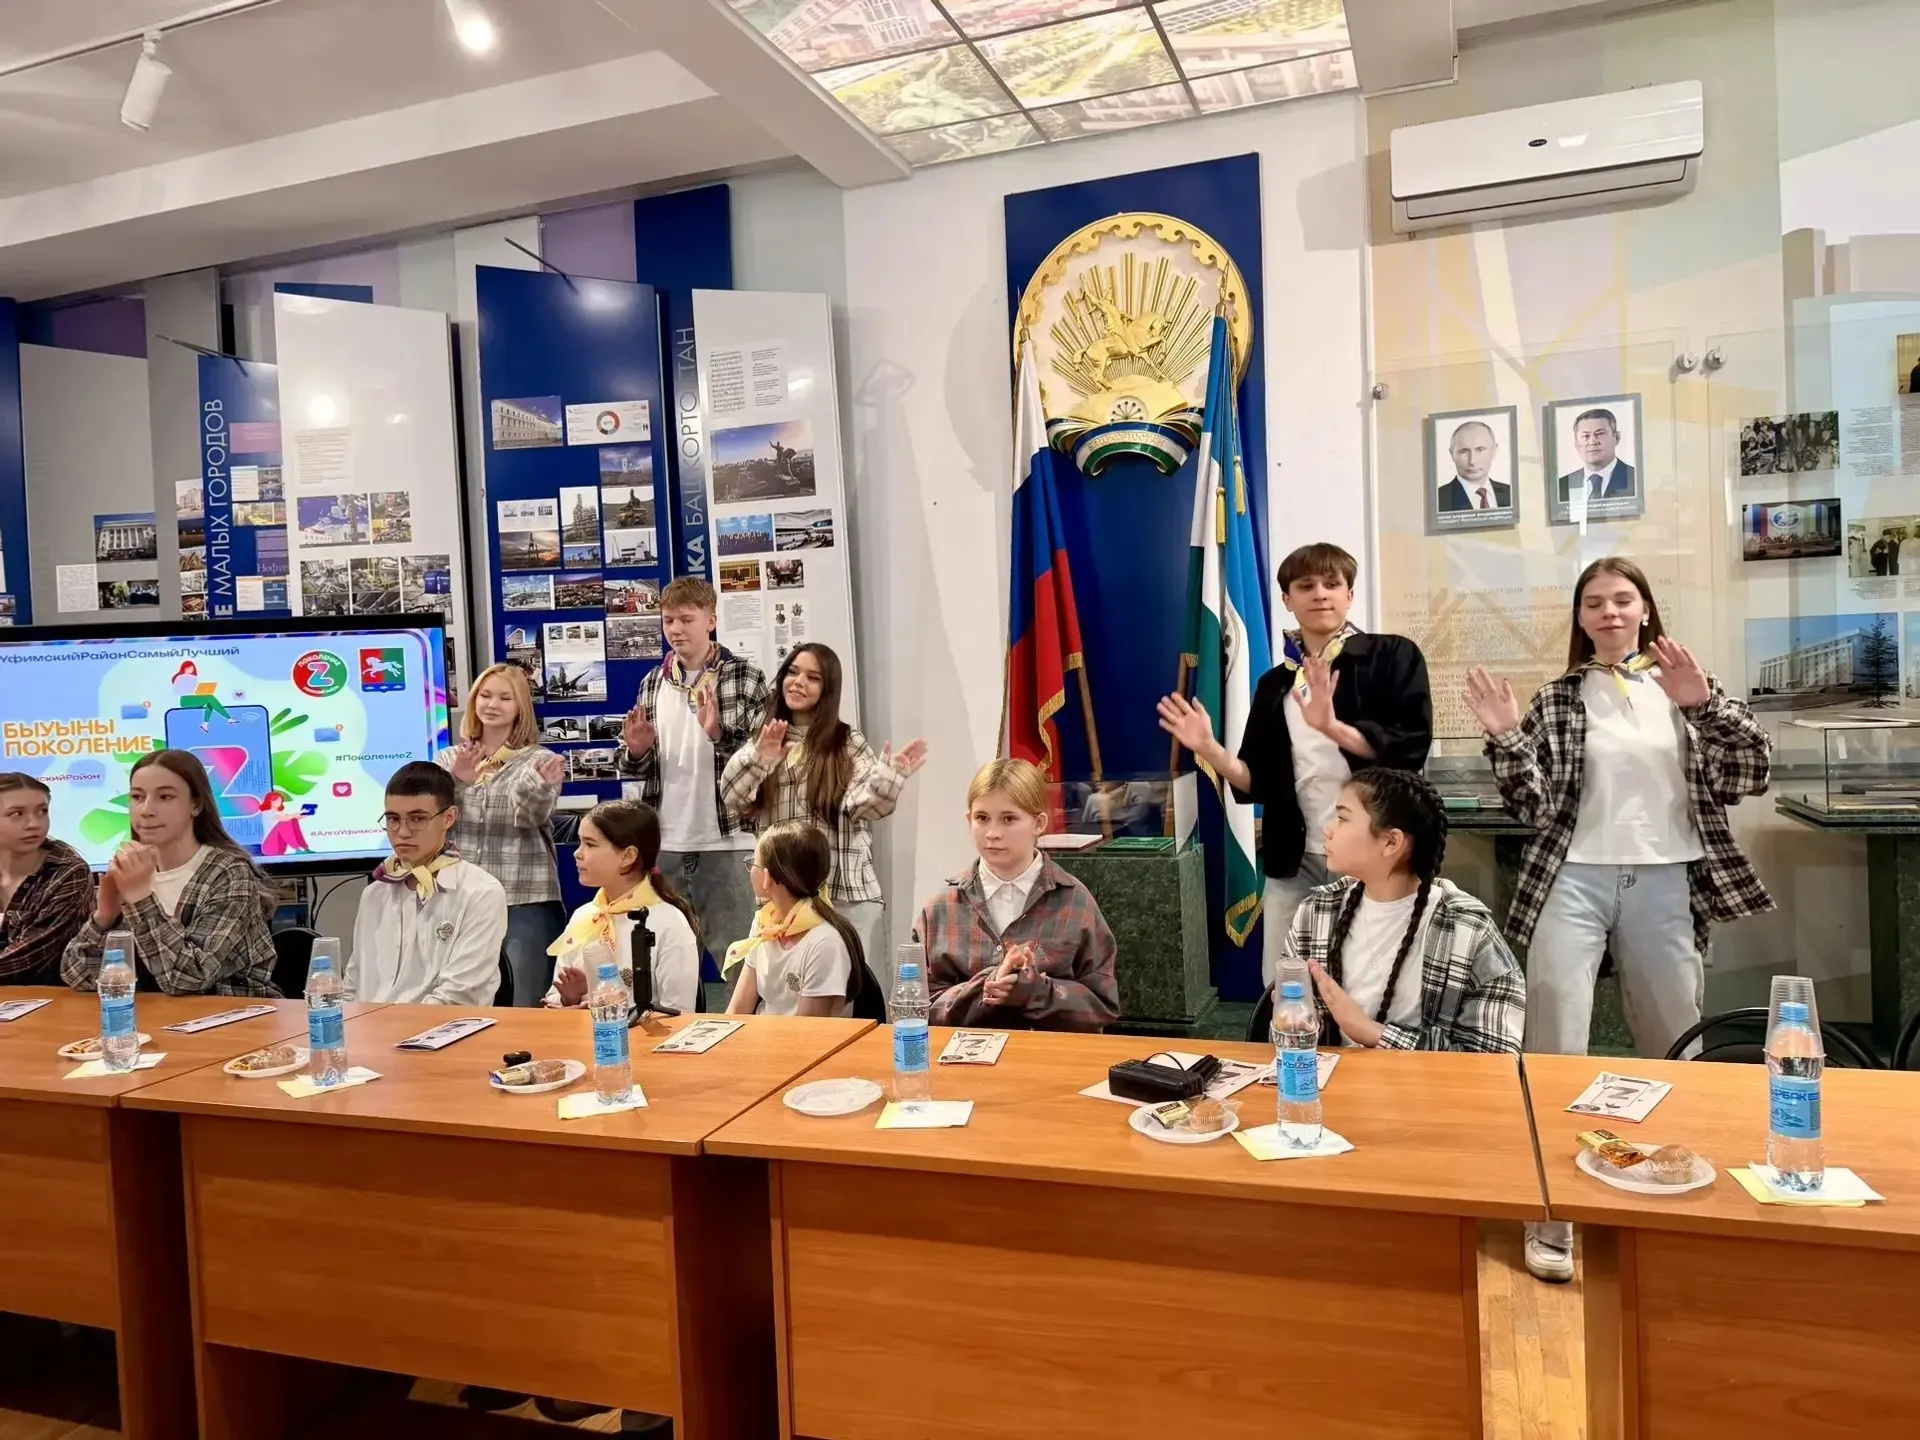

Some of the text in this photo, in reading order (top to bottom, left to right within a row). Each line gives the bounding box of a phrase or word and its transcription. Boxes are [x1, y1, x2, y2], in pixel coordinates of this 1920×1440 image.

[204, 399, 228, 507] ГОРОДОВ
[210, 513, 233, 596] МАЛЫХ
[307, 661, 335, 687] Z
[4, 719, 115, 739] БЫУЫНЫ
[5, 735, 153, 757] ПОКОЛЕНИЕ
[335, 751, 413, 762] #ПоколениеZ
